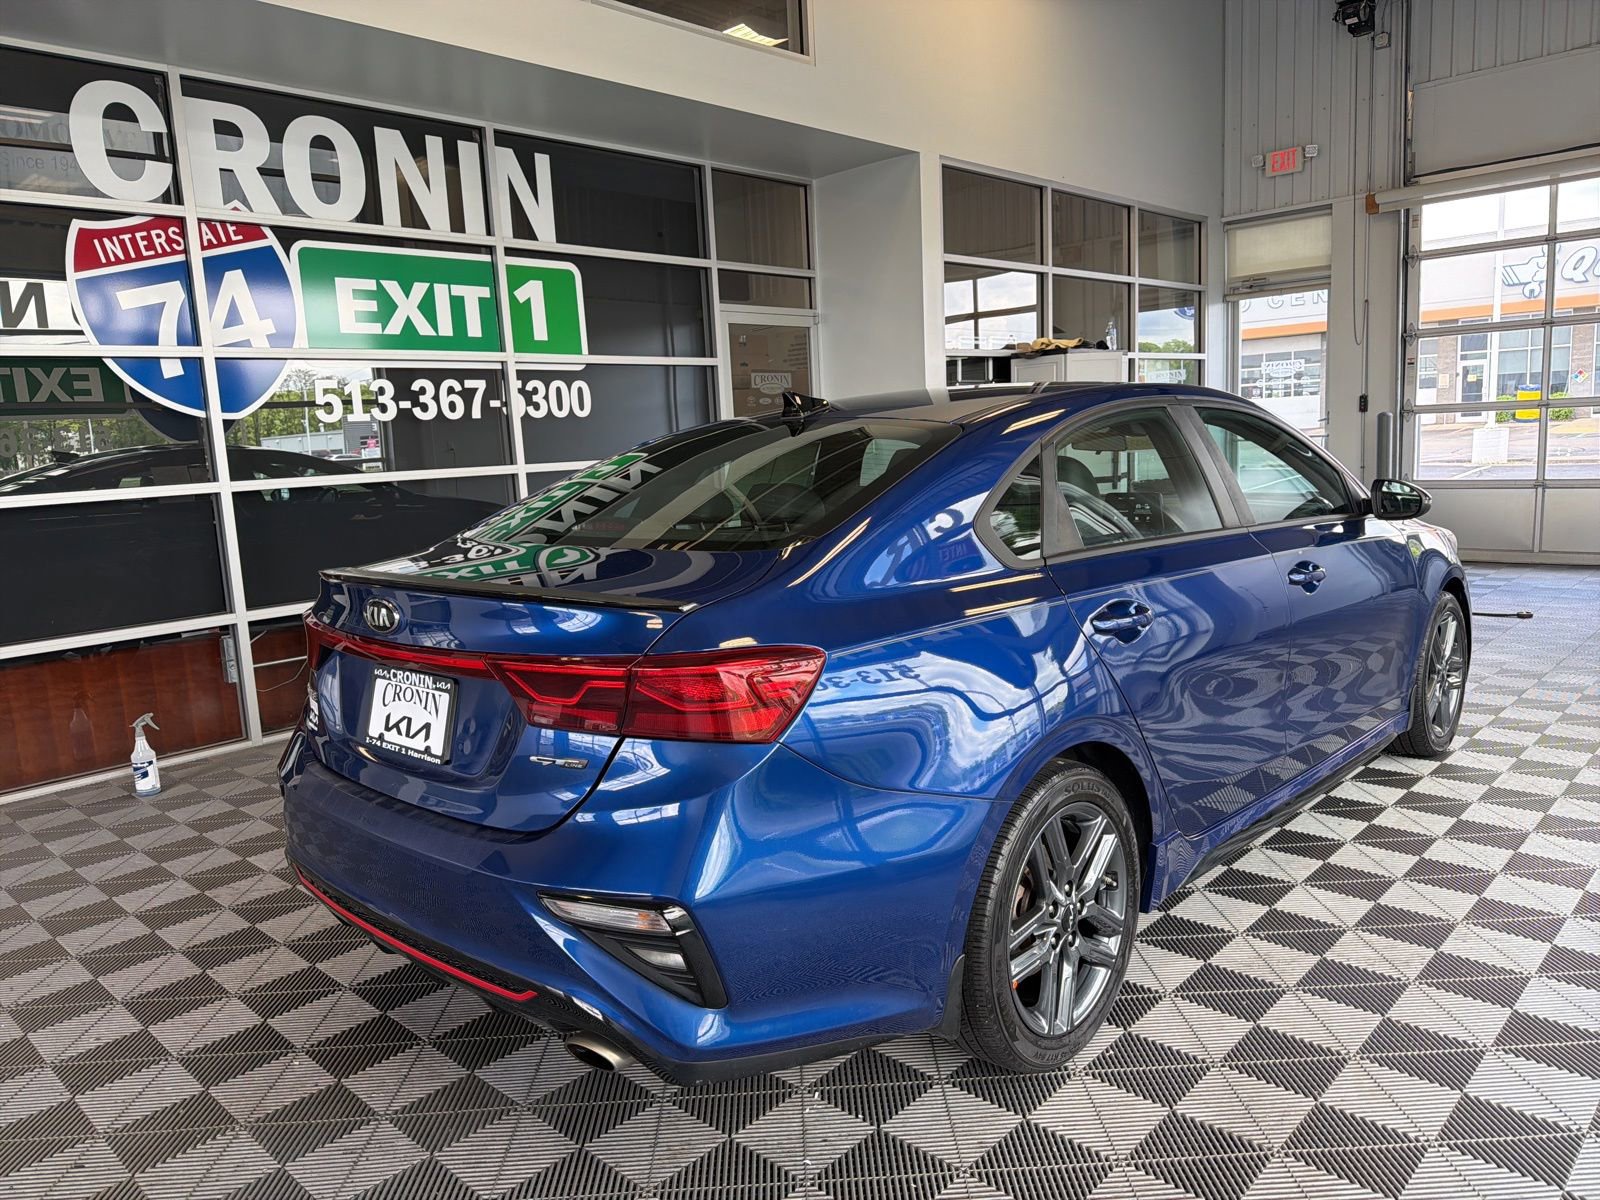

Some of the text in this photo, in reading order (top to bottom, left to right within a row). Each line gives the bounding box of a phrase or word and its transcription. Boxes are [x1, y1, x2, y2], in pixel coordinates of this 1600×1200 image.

[50, 155, 78, 177] 194
[69, 80, 556, 243] CRONIN
[1271, 148, 1298, 173] EXIT
[93, 221, 243, 264] INTERSATE
[115, 269, 276, 379] 74
[334, 277, 549, 342] EXIT 1
[754, 374, 790, 387] CRONIN
[314, 378, 592, 424] 513-367-5300
[367, 606, 391, 627] KIA
[390, 669, 434, 690] CRONIN
[382, 682, 442, 720] CRONIN
[366, 736, 382, 747] I-74
[382, 741, 401, 752] EXIT
[407, 749, 441, 765] Harrison
[1064, 781, 1101, 796] SOLUS
